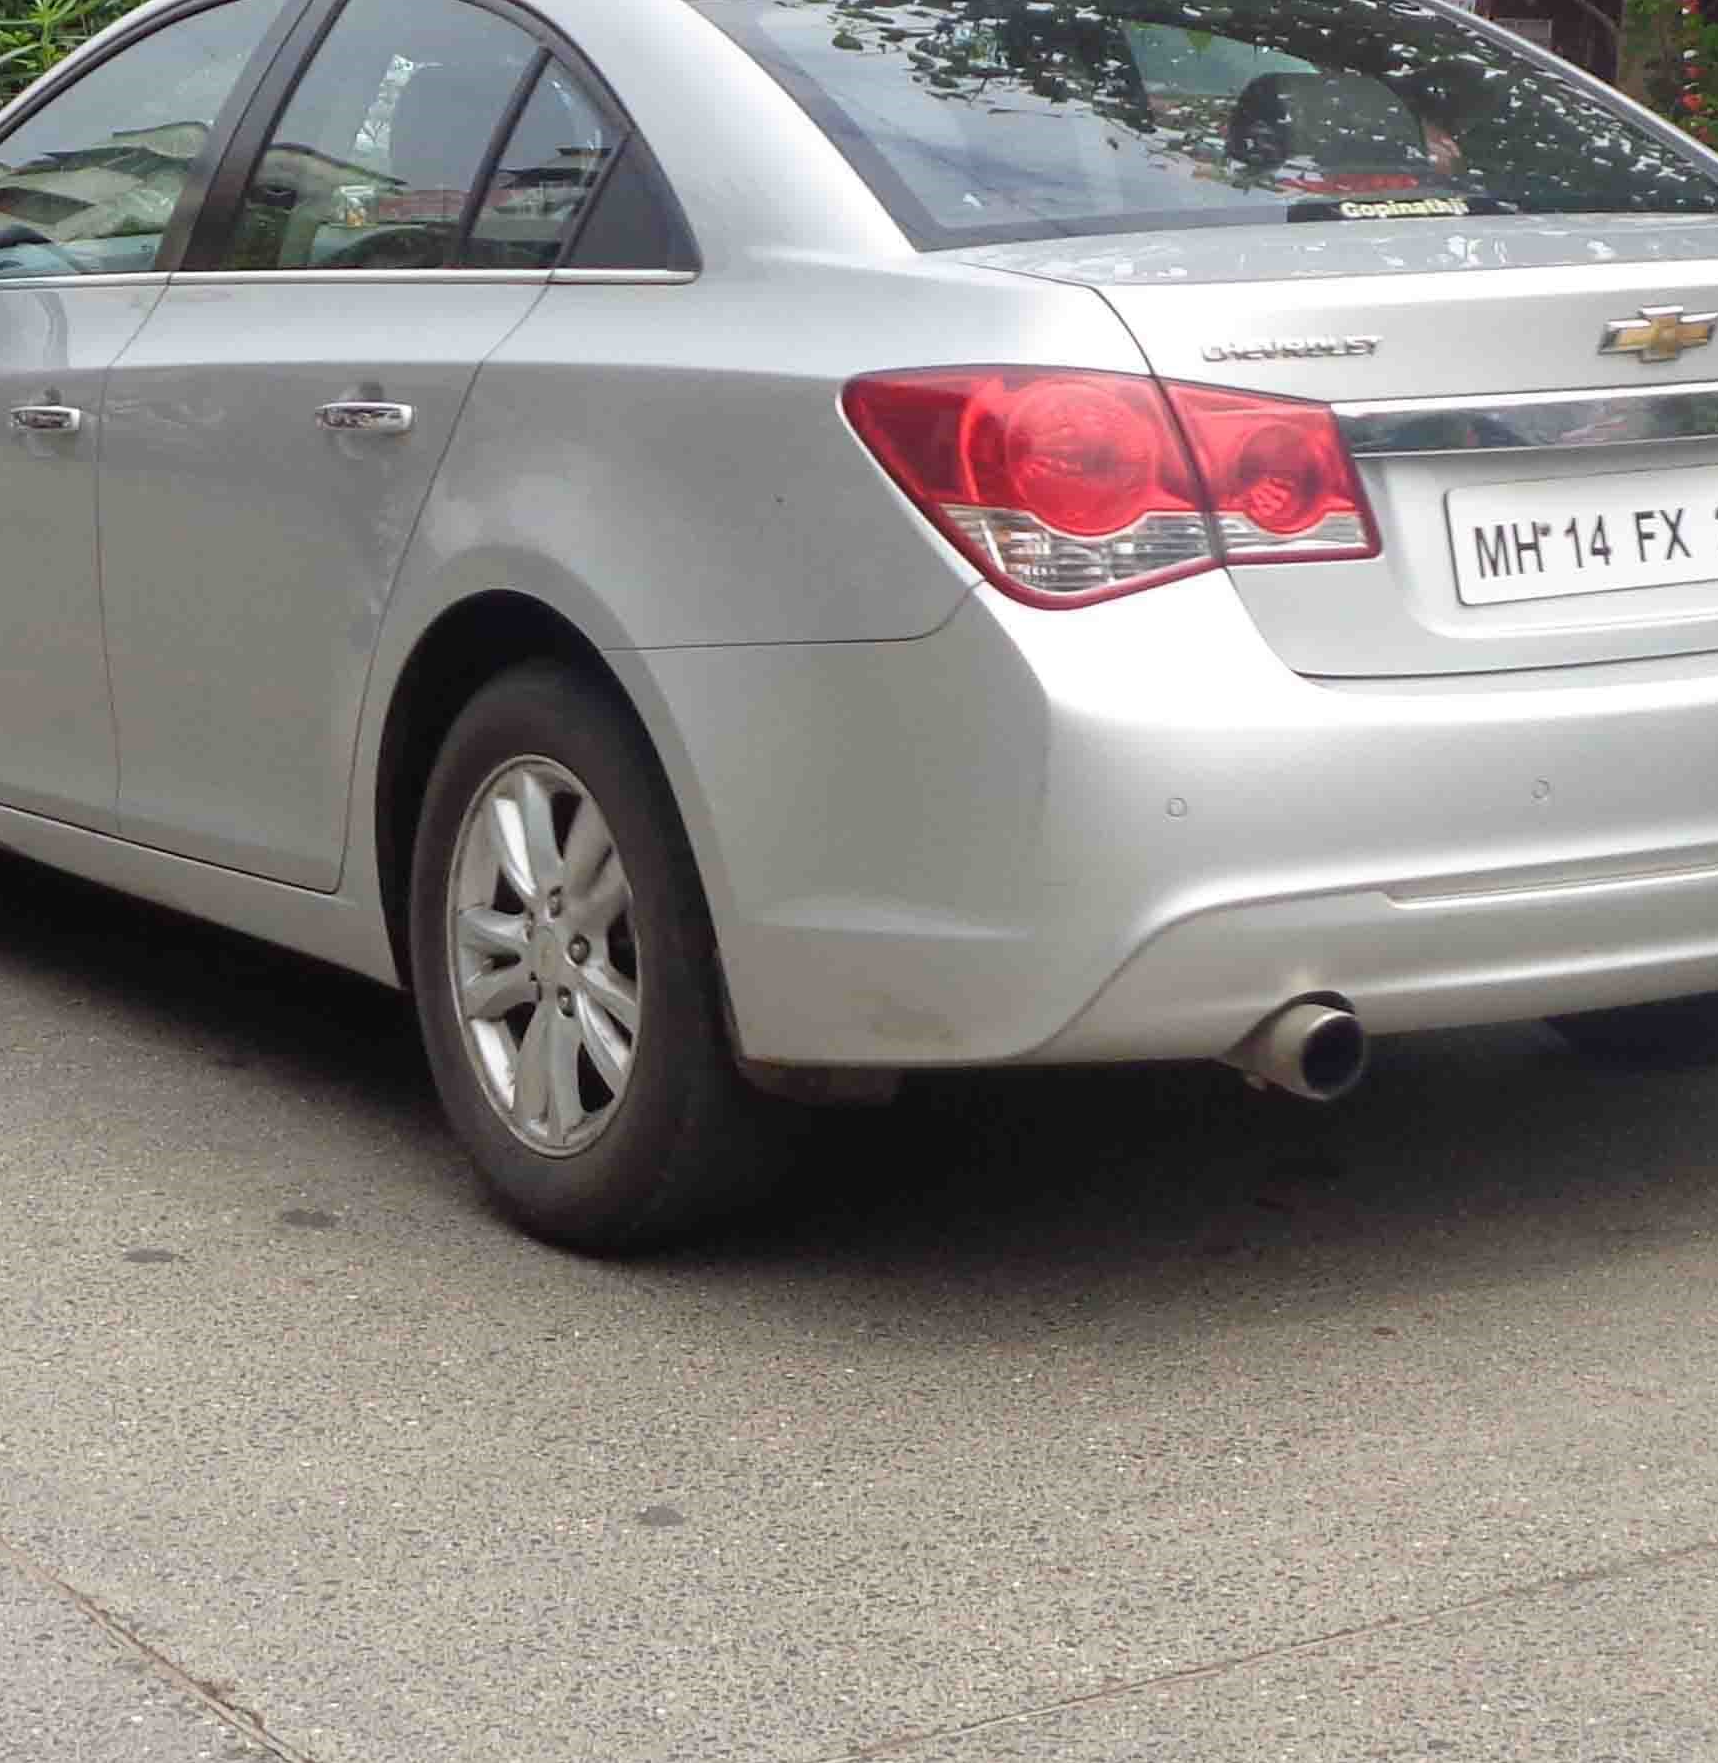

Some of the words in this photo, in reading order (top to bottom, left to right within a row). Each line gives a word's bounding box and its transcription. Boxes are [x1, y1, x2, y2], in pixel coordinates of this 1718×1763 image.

[1340, 197, 1471, 220] Gopinathji
[1474, 520, 1549, 579] MH
[1564, 515, 1611, 568] 14
[1634, 508, 1692, 563] FX
